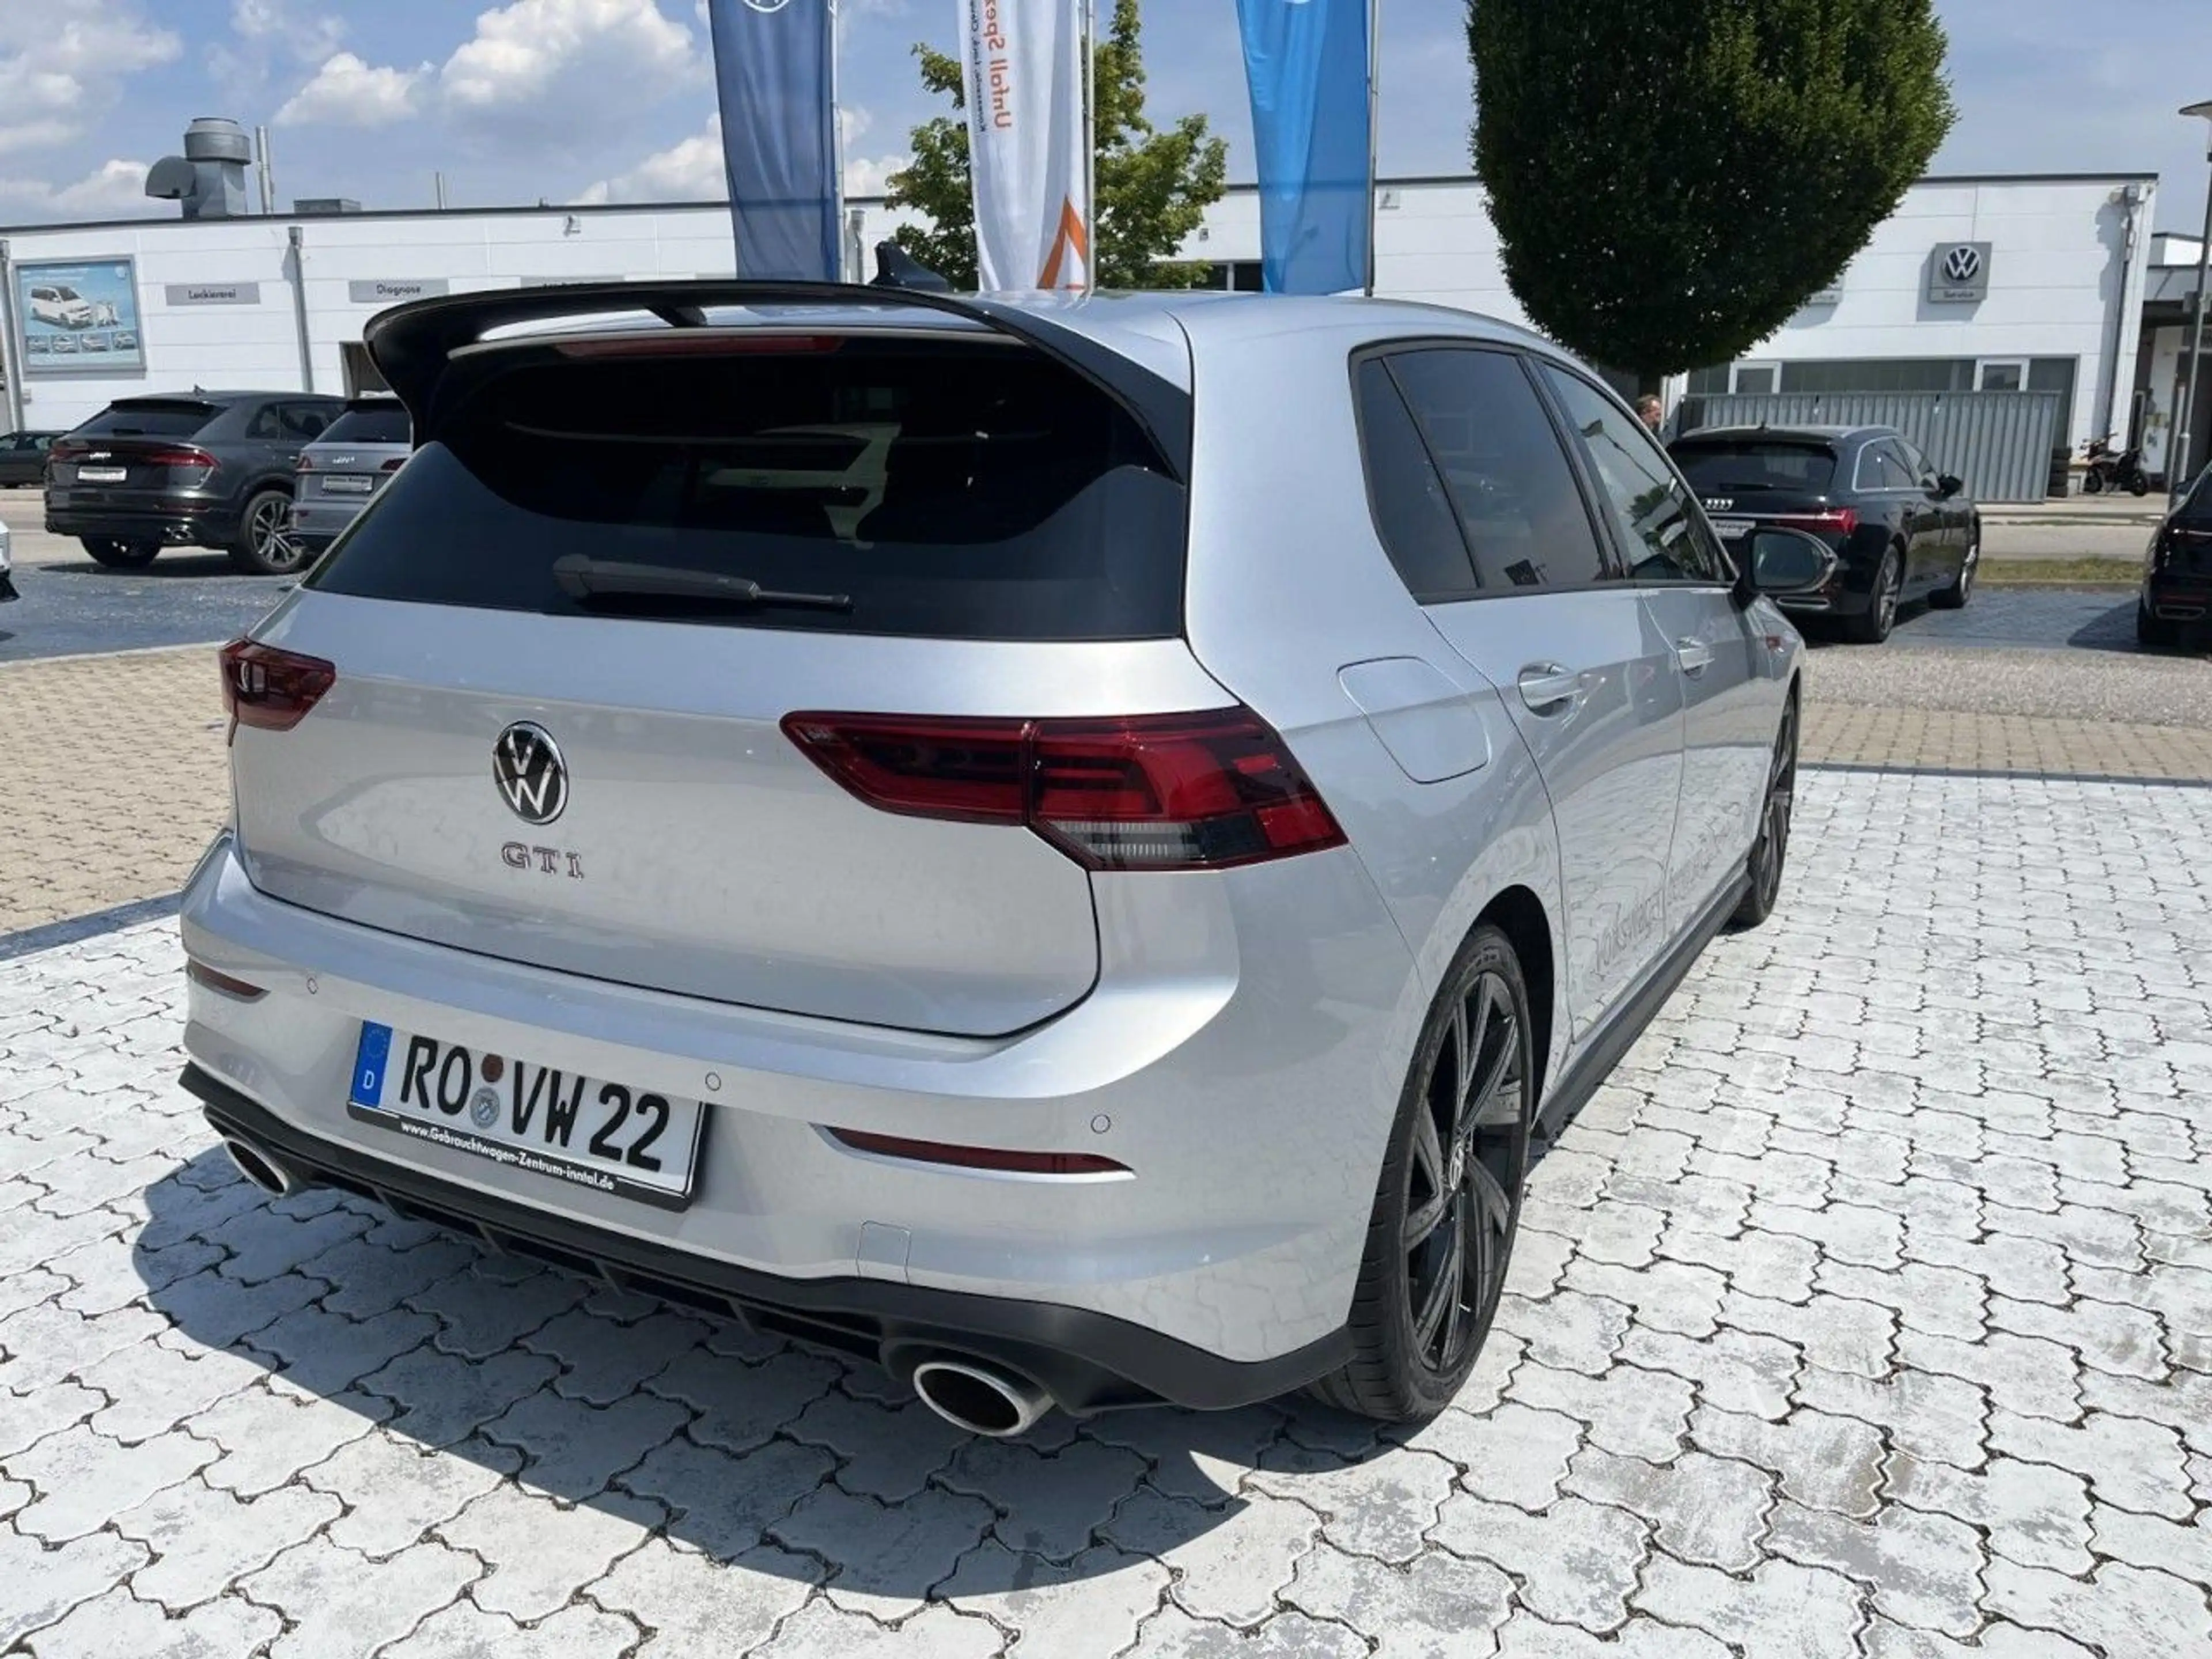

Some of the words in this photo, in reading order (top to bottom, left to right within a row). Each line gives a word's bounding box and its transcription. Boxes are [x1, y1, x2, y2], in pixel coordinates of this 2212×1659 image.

[501, 842, 584, 880] GTI
[363, 1069, 374, 1090] D
[400, 1035, 472, 1116] RO
[511, 1060, 585, 1148] VW
[589, 1084, 671, 1172] 22
